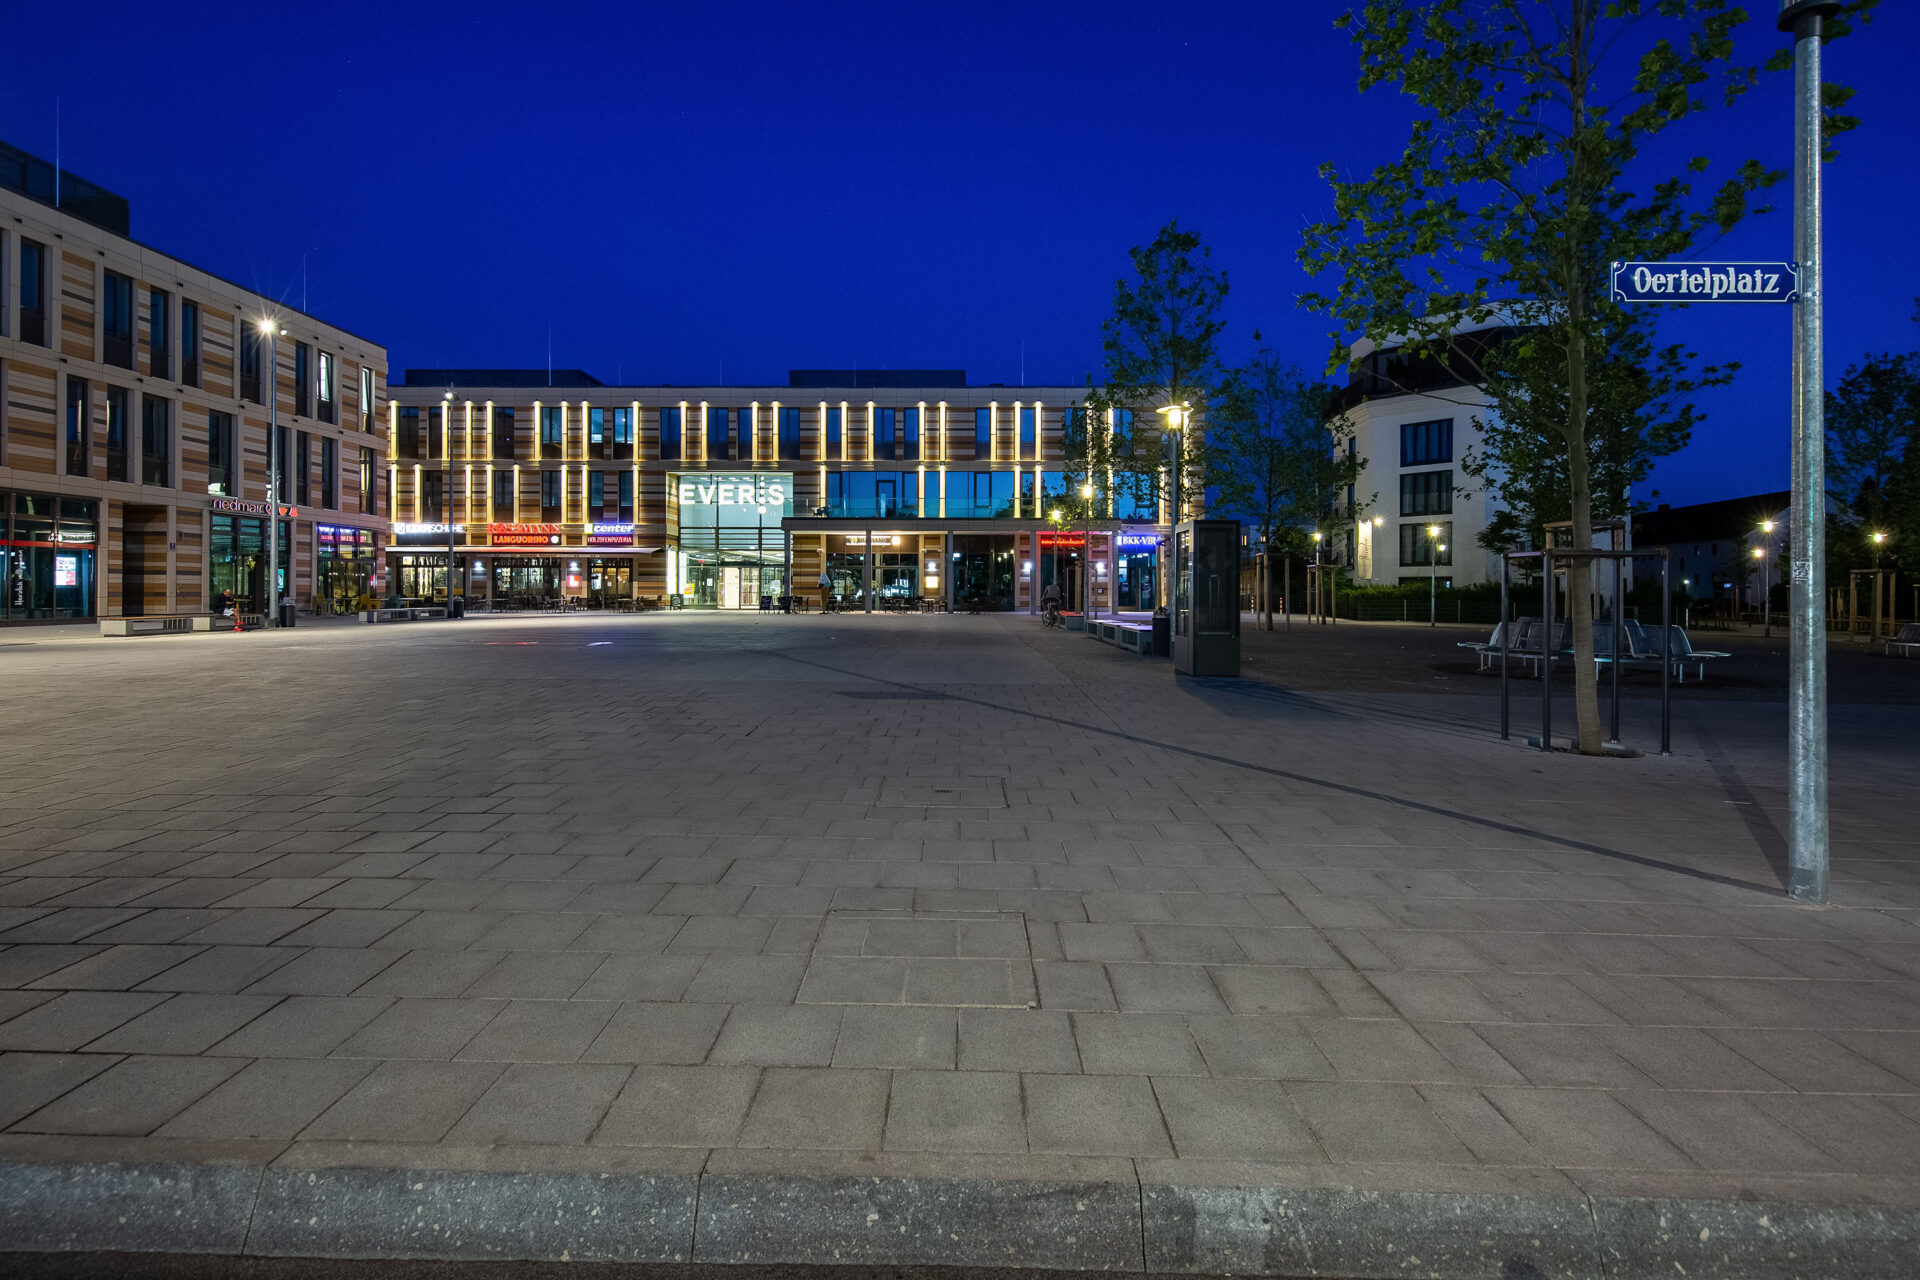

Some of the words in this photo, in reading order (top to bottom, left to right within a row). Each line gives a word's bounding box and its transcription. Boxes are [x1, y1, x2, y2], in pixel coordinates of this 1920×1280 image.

[1634, 266, 1780, 299] Oertelplatz
[488, 523, 561, 533] ROSSMANN
[593, 524, 634, 532] center
[493, 535, 548, 543] LANGUORINO
